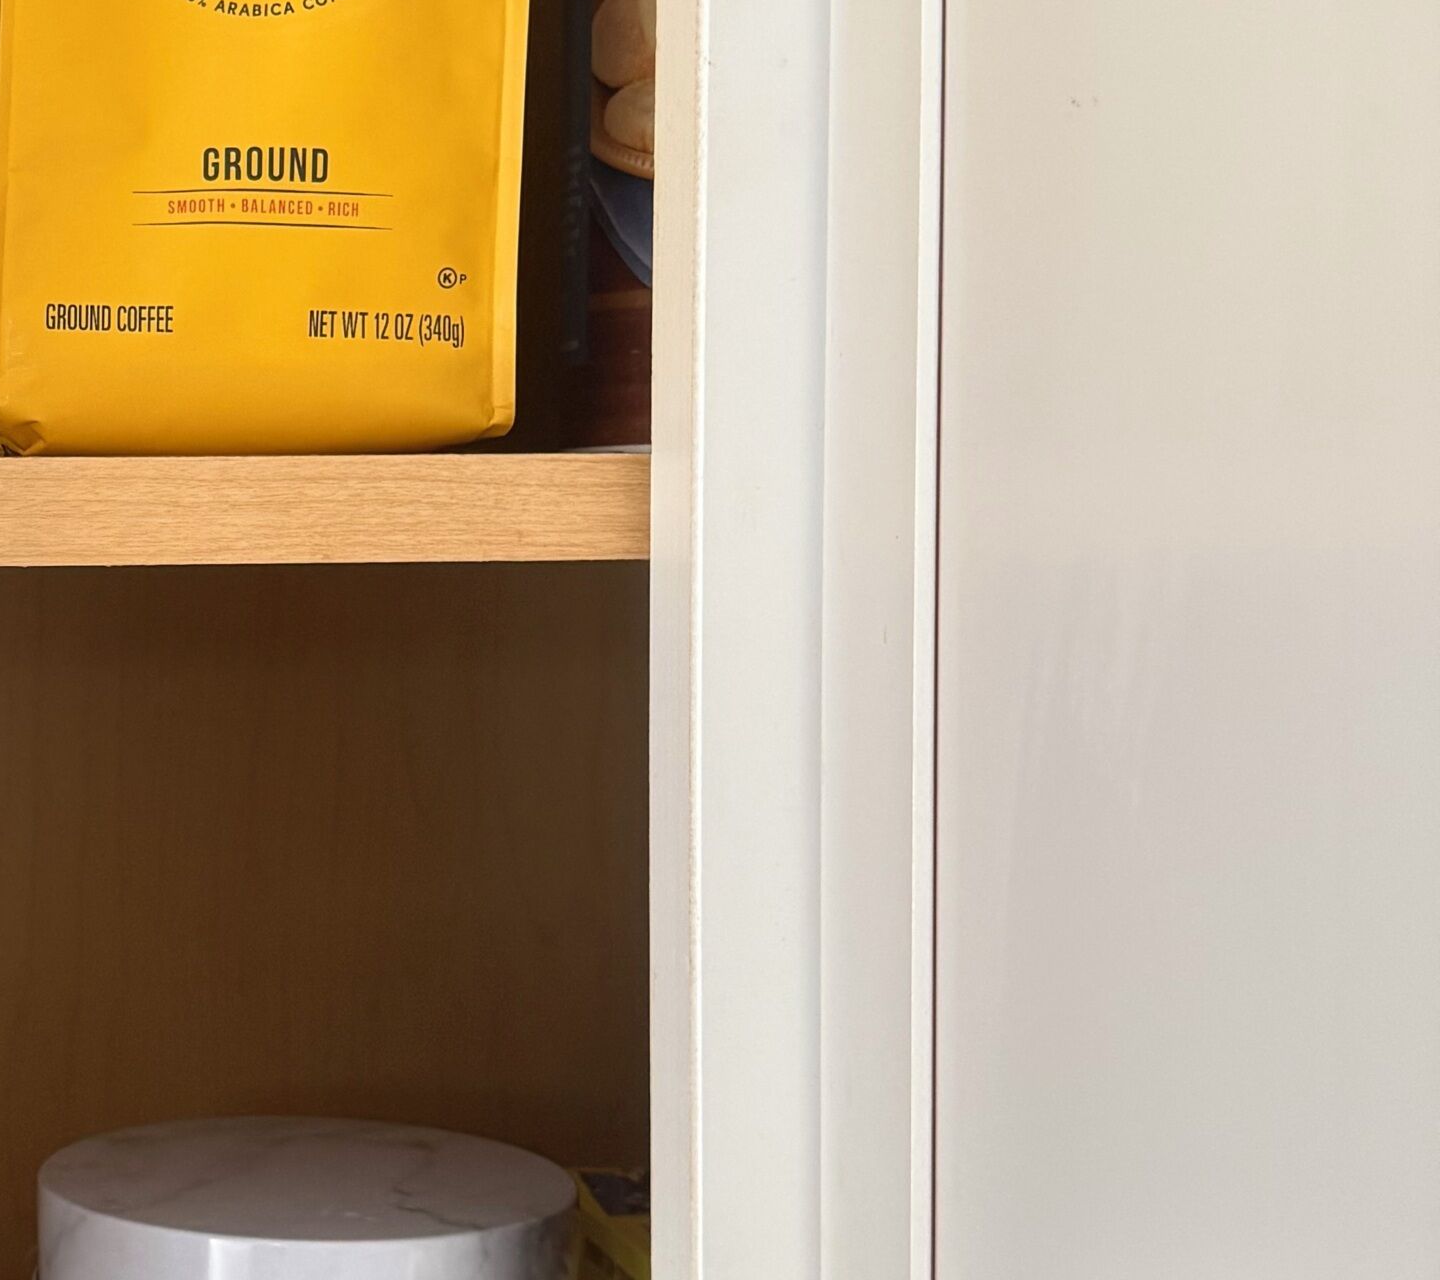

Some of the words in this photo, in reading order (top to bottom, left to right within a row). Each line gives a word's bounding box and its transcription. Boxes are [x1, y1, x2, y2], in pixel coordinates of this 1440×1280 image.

[214, 0, 295, 17] ARABICA
[202, 146, 329, 184] GROUND
[167, 198, 225, 215] SMOOTH
[241, 198, 313, 216] BALANCED
[327, 201, 359, 217] RICH
[45, 303, 112, 332] GROUND
[116, 305, 174, 333] COFFEE
[308, 309, 338, 338] NET
[341, 310, 369, 339] WT
[374, 312, 390, 340] 12
[394, 312, 414, 341] OZ
[418, 314, 465, 349] (340g)
